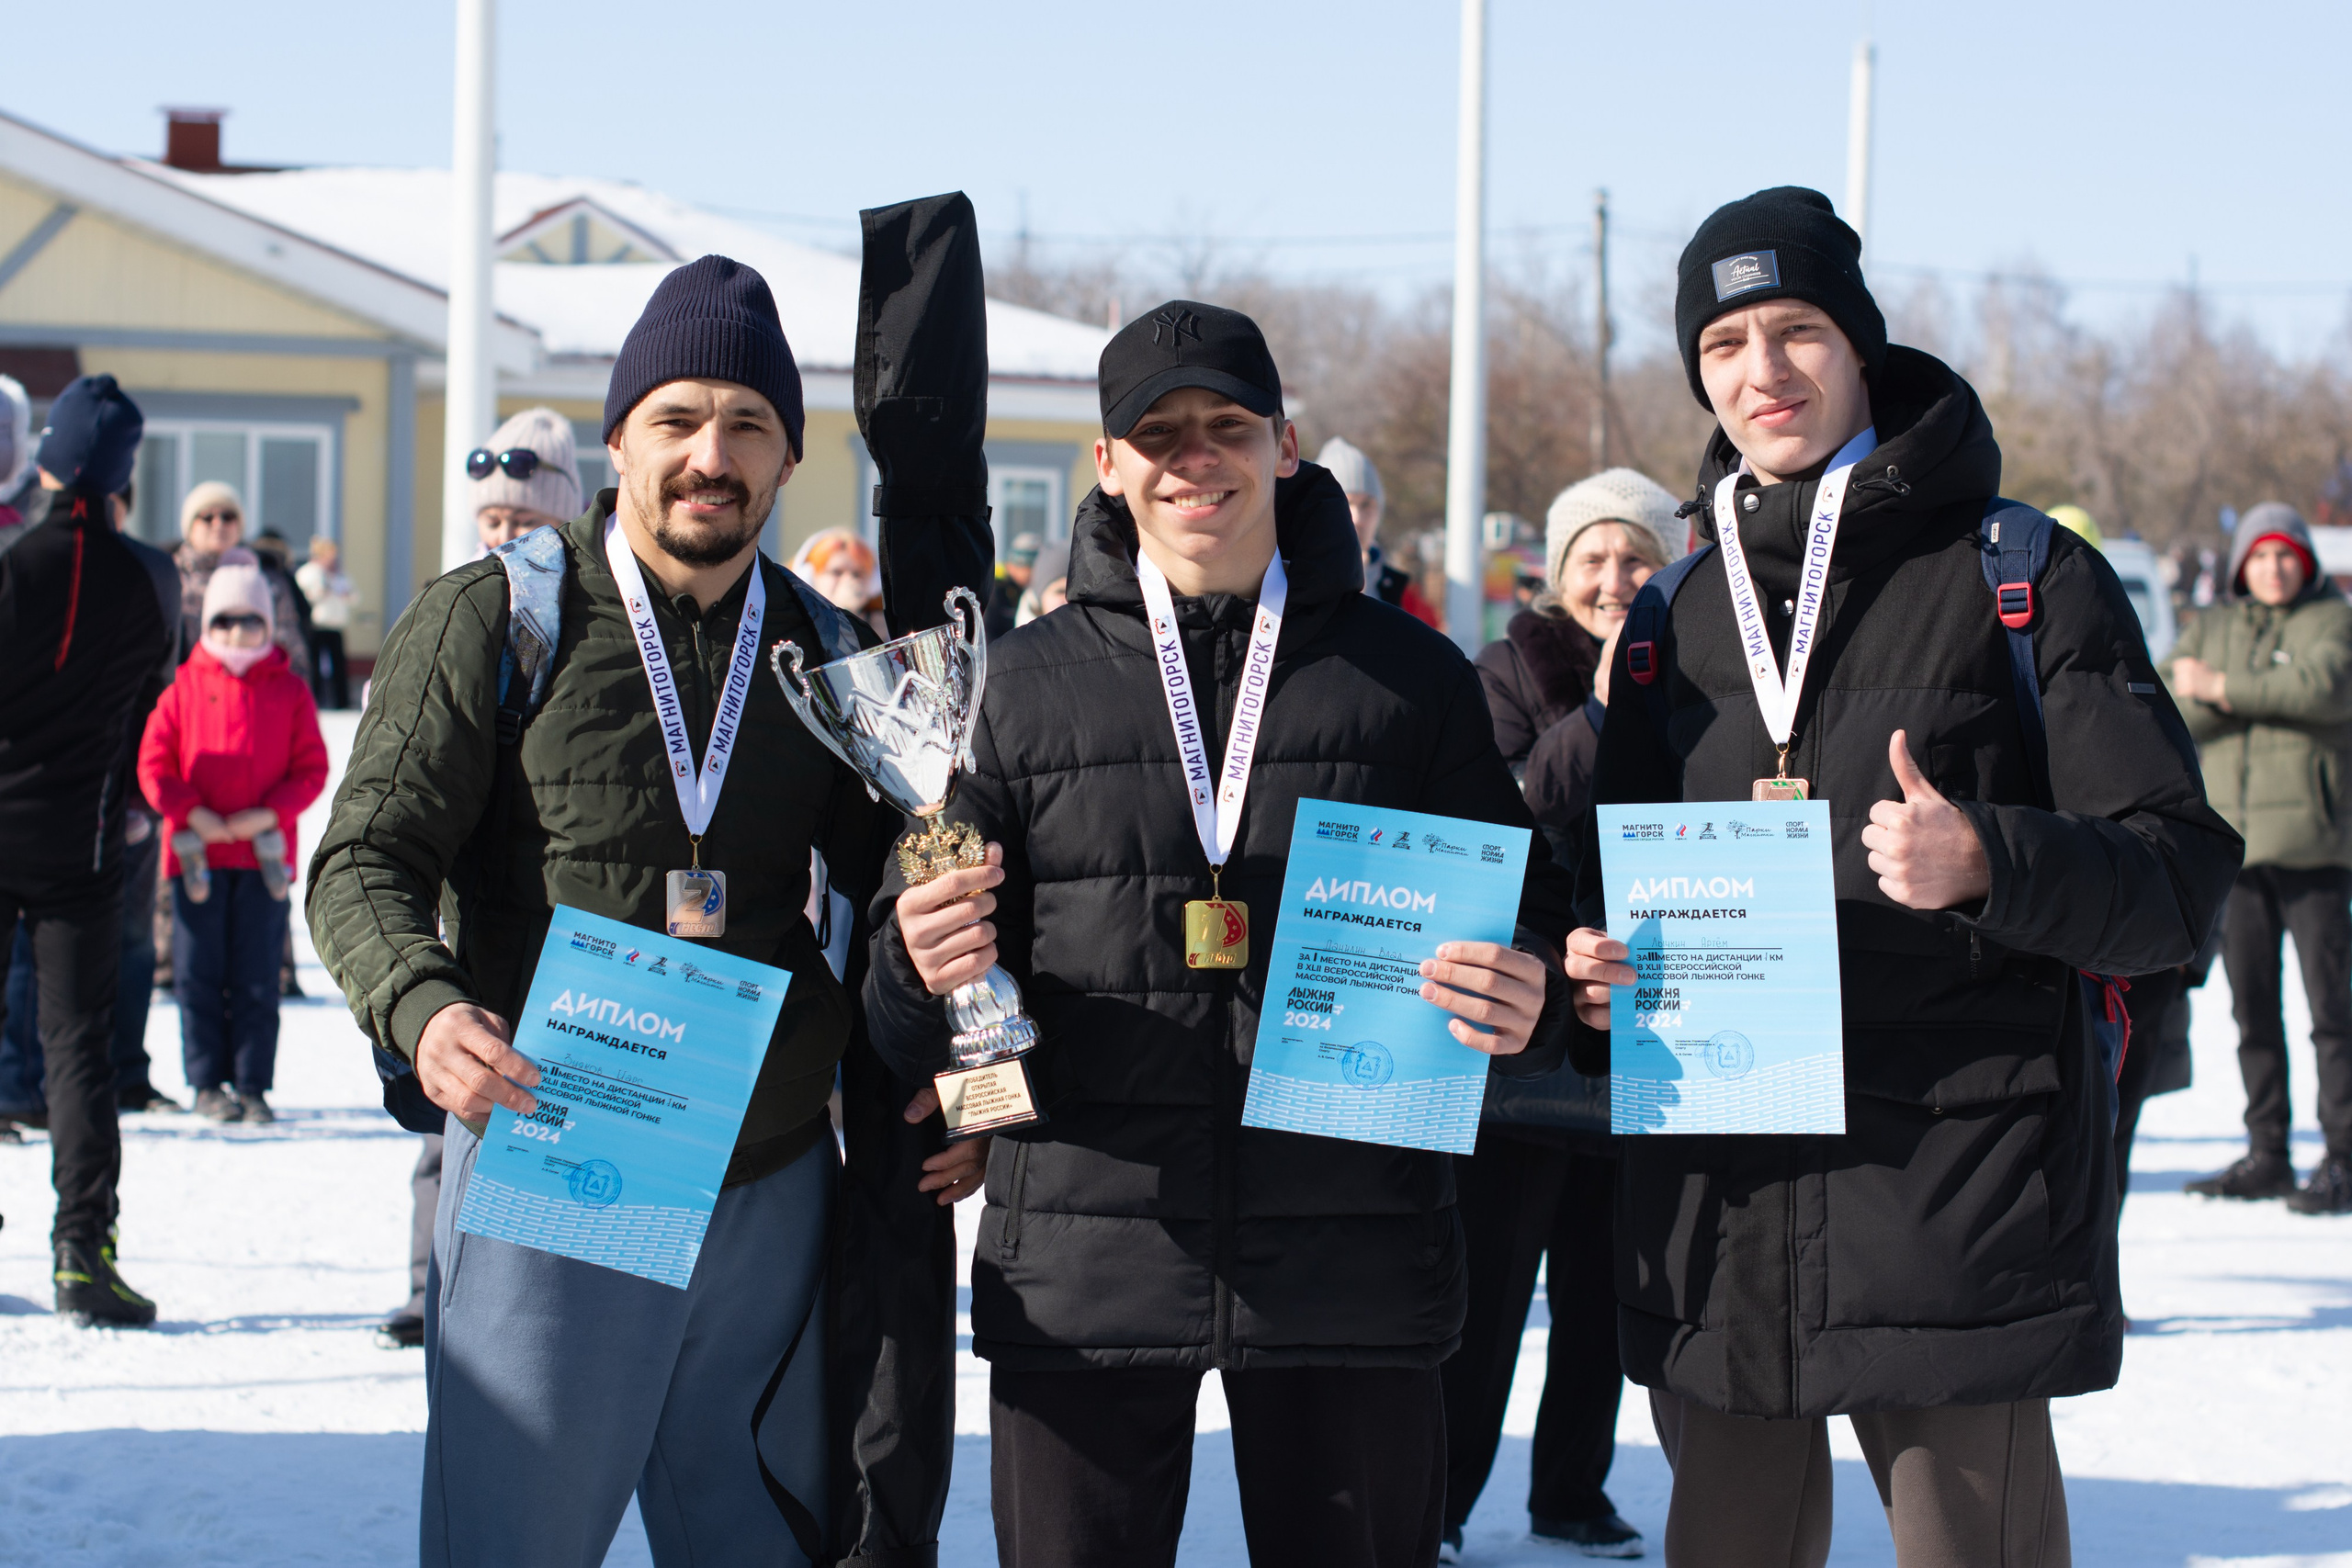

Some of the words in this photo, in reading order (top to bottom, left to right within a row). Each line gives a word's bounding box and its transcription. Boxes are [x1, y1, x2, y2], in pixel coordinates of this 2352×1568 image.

[1152, 310, 1203, 345] NY
[1722, 520, 1766, 657] МАГНИТОГОРСК
[1795, 511, 1834, 654] МАГНИТОГОРСК
[636, 619, 685, 754] МАГНИТОГОРСК
[713, 624, 758, 754] МАГНИТОГОРСК
[1159, 639, 1205, 781] МАГНИТОГОРСК
[1228, 639, 1272, 781] МАГНИТОГОРСК
[1317, 821, 1360, 831] МАГНИТО
[1330, 829, 1358, 839] ГОРСК
[1481, 850, 1504, 858] НОРМА
[1305, 875, 1437, 914] ДИПЛОМ
[1627, 876, 1755, 903] ДИПЛОМ
[672, 877, 713, 922] 2
[1303, 907, 1422, 932] НАГРАЖДАЕТСЯ
[1630, 908, 1747, 919] НАГРАЖДАЕТСЯ
[574, 931, 616, 949] МАГНИТО
[1193, 908, 1227, 953] 1
[585, 942, 615, 956] ГОРСК
[1298, 953, 1310, 961] ЗА
[1319, 955, 1351, 965] МЕСТО
[1353, 960, 1367, 968] НА
[1369, 963, 1422, 977] ДИСТАНЦИ
[1306, 964, 1321, 972] XLII
[1324, 966, 1404, 983] ВСЕРОССИЙСКОЙ
[1664, 962, 1742, 970] ВСЕРОССИЙСКОЙ
[740, 980, 759, 989] СПОРТ
[1295, 972, 1348, 985] МАССОВОЙ
[1349, 979, 1394, 992] ЛЫЖНОЙ
[1396, 986, 1420, 996] ГОНК
[1690, 972, 1734, 980] ЛЫЖНОЙ
[736, 992, 759, 1002] ЖИЗНИ
[738, 987, 761, 997] НОРМА
[1288, 987, 1335, 1002] ЛЫЖНЯ
[1634, 988, 1680, 998] ЛЫЖНЯ
[1287, 998, 1333, 1013] РОССИИ
[1635, 999, 1680, 1010] РОССИИ
[550, 988, 686, 1043] ДИПЛОМ
[1283, 1010, 1331, 1031] 2024
[1635, 1012, 1683, 1027] 2024
[546, 1018, 667, 1060] НАГРАЖДАЕТСЯ
[537, 1064, 548, 1073] ЗА
[558, 1070, 590, 1084] МЕСТО
[592, 1079, 605, 1089] НА
[606, 1084, 665, 1105] ДИСТАНЦИИ
[672, 1101, 687, 1111] КМ
[966, 1073, 998, 1084] ПОБЕДИТЕЛЬ
[971, 1081, 997, 1091] ОТКРЫТАЯ
[541, 1076, 559, 1086] XLII
[560, 1081, 641, 1109] ВСЕРОССИЙСКОЙ
[966, 1088, 1007, 1100] ВСЕРОССИЙСКАЯ
[537, 1099, 569, 1117] ЖНЯ
[584, 1098, 629, 1115] ЛЫЖНОЙ
[631, 1110, 662, 1124] ГОНКЕ
[956, 1101, 982, 1111] МАССОВАЯ
[983, 1096, 1004, 1106] ЛЫЖНАЯ
[510, 1119, 561, 1144] 2024
